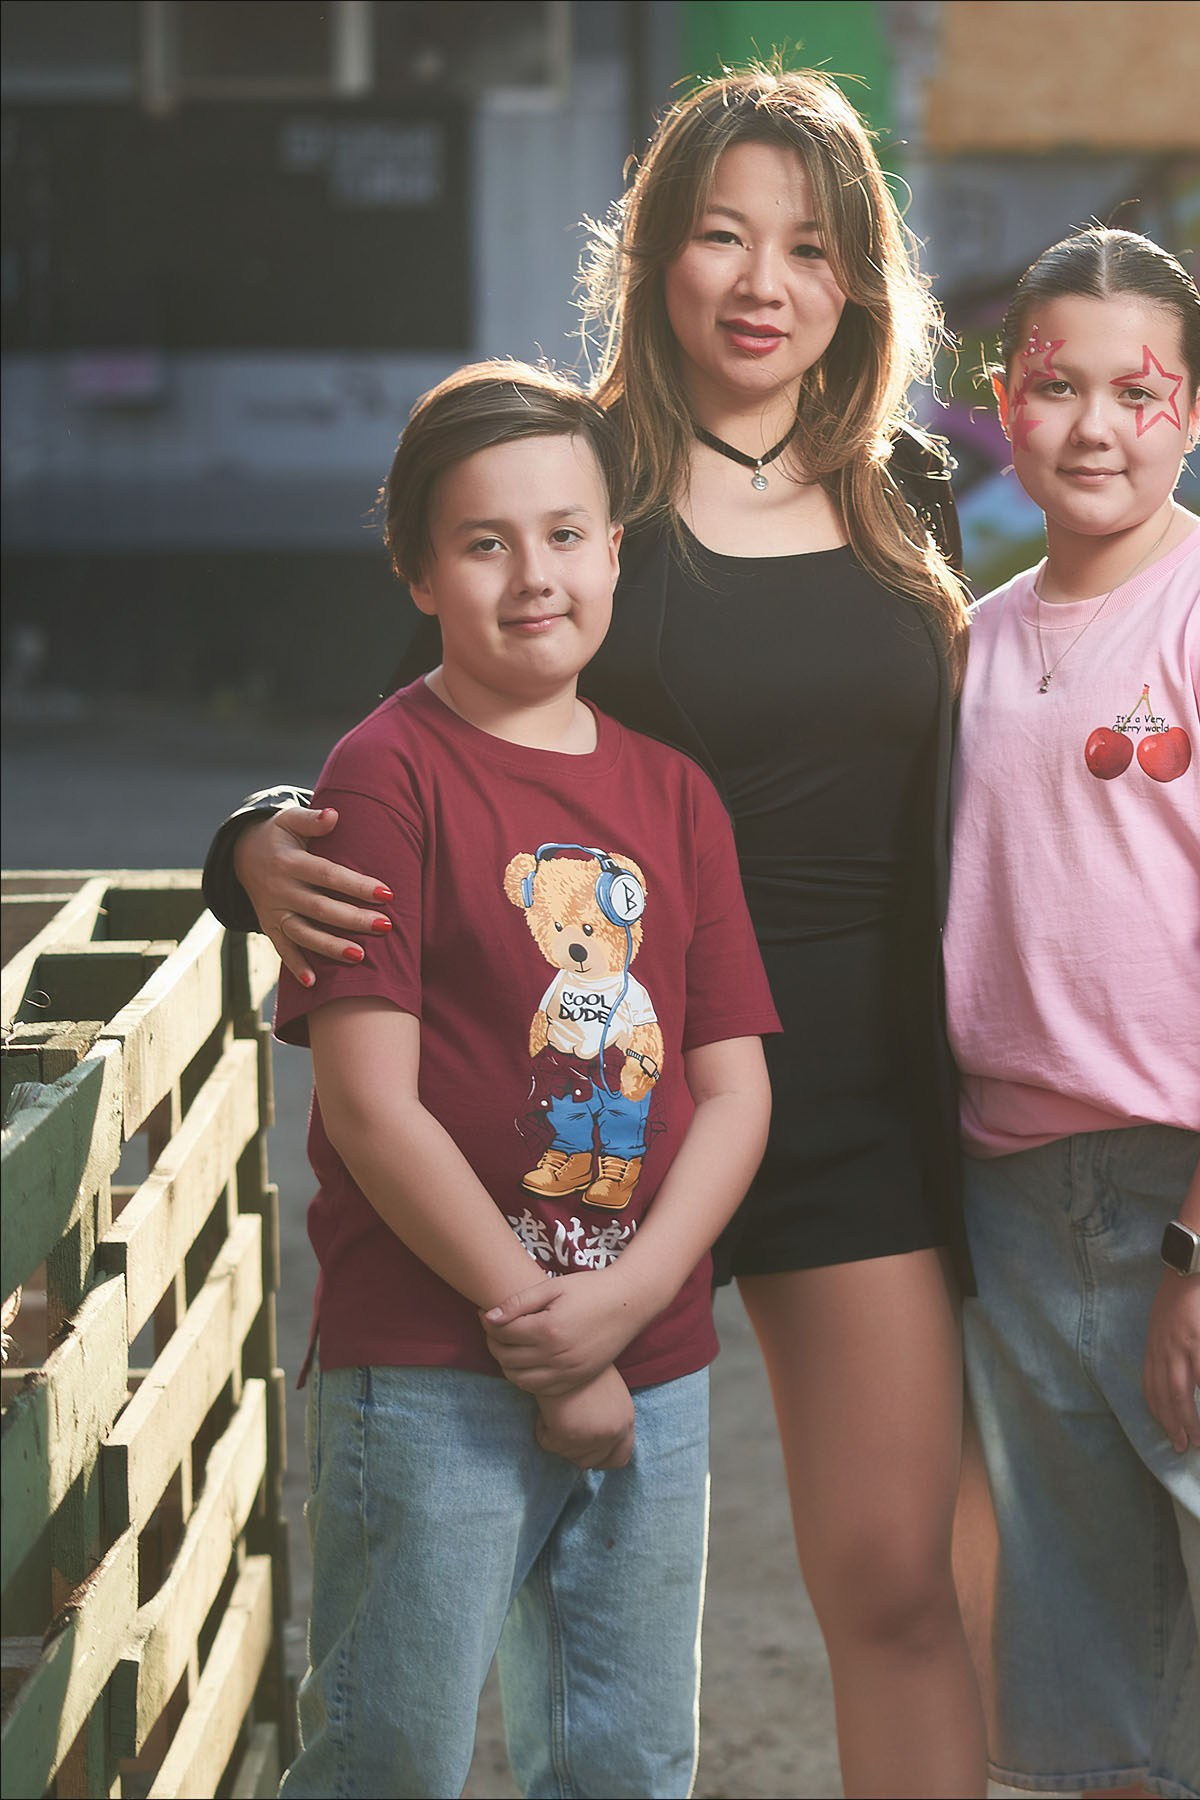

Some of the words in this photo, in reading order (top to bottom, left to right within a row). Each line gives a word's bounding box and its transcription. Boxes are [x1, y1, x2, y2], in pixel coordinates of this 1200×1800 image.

[1116, 715, 1131, 723] It's
[1144, 715, 1166, 727] Very
[1112, 724, 1141, 734] Cherry
[1145, 724, 1169, 733] world
[562, 991, 612, 1010] COOL
[559, 1003, 611, 1026] DUDE
